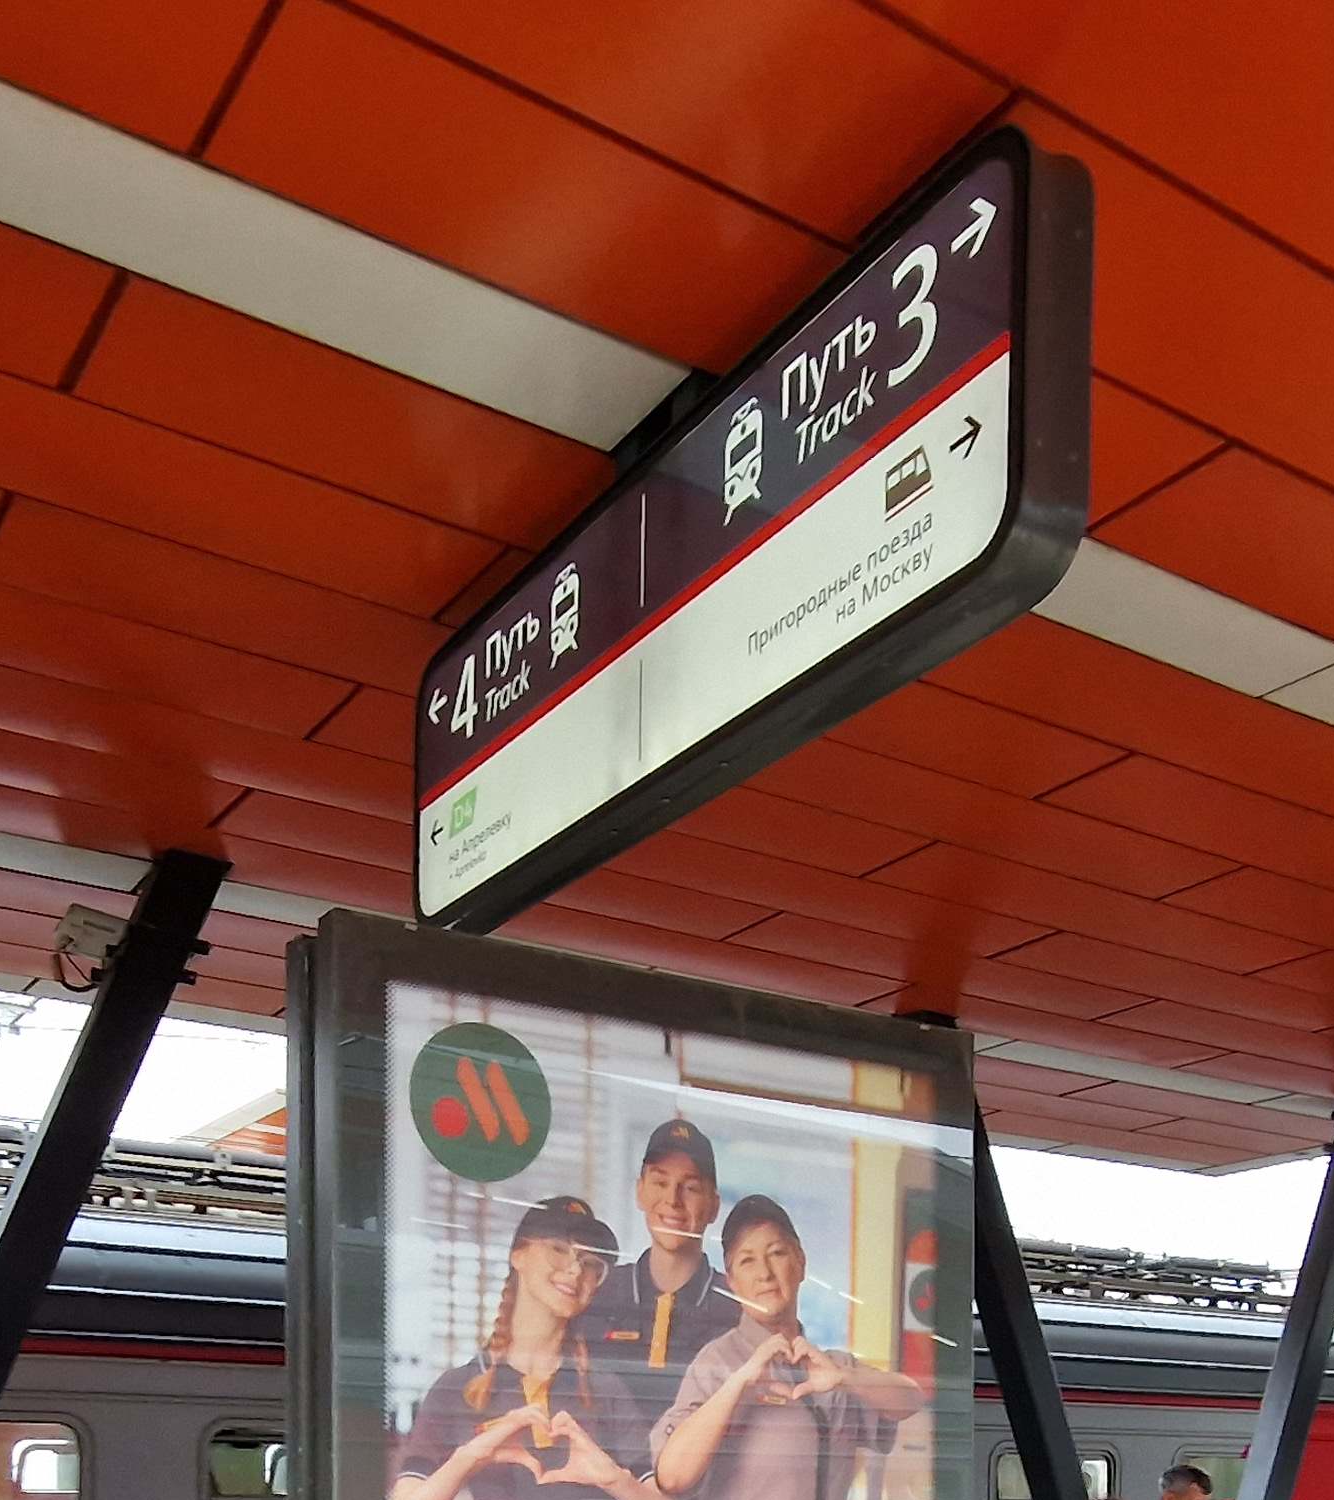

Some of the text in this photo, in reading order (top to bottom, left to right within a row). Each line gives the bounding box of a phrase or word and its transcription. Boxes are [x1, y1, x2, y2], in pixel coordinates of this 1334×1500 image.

[887, 243, 938, 389] 3
[781, 315, 877, 421] Путь
[795, 365, 878, 465] Track
[748, 512, 933, 656] Пригородные поезда
[836, 543, 933, 624] на Москву
[485, 611, 540, 679] Путь
[485, 659, 532, 722] Track
[451, 653, 479, 739] 4
